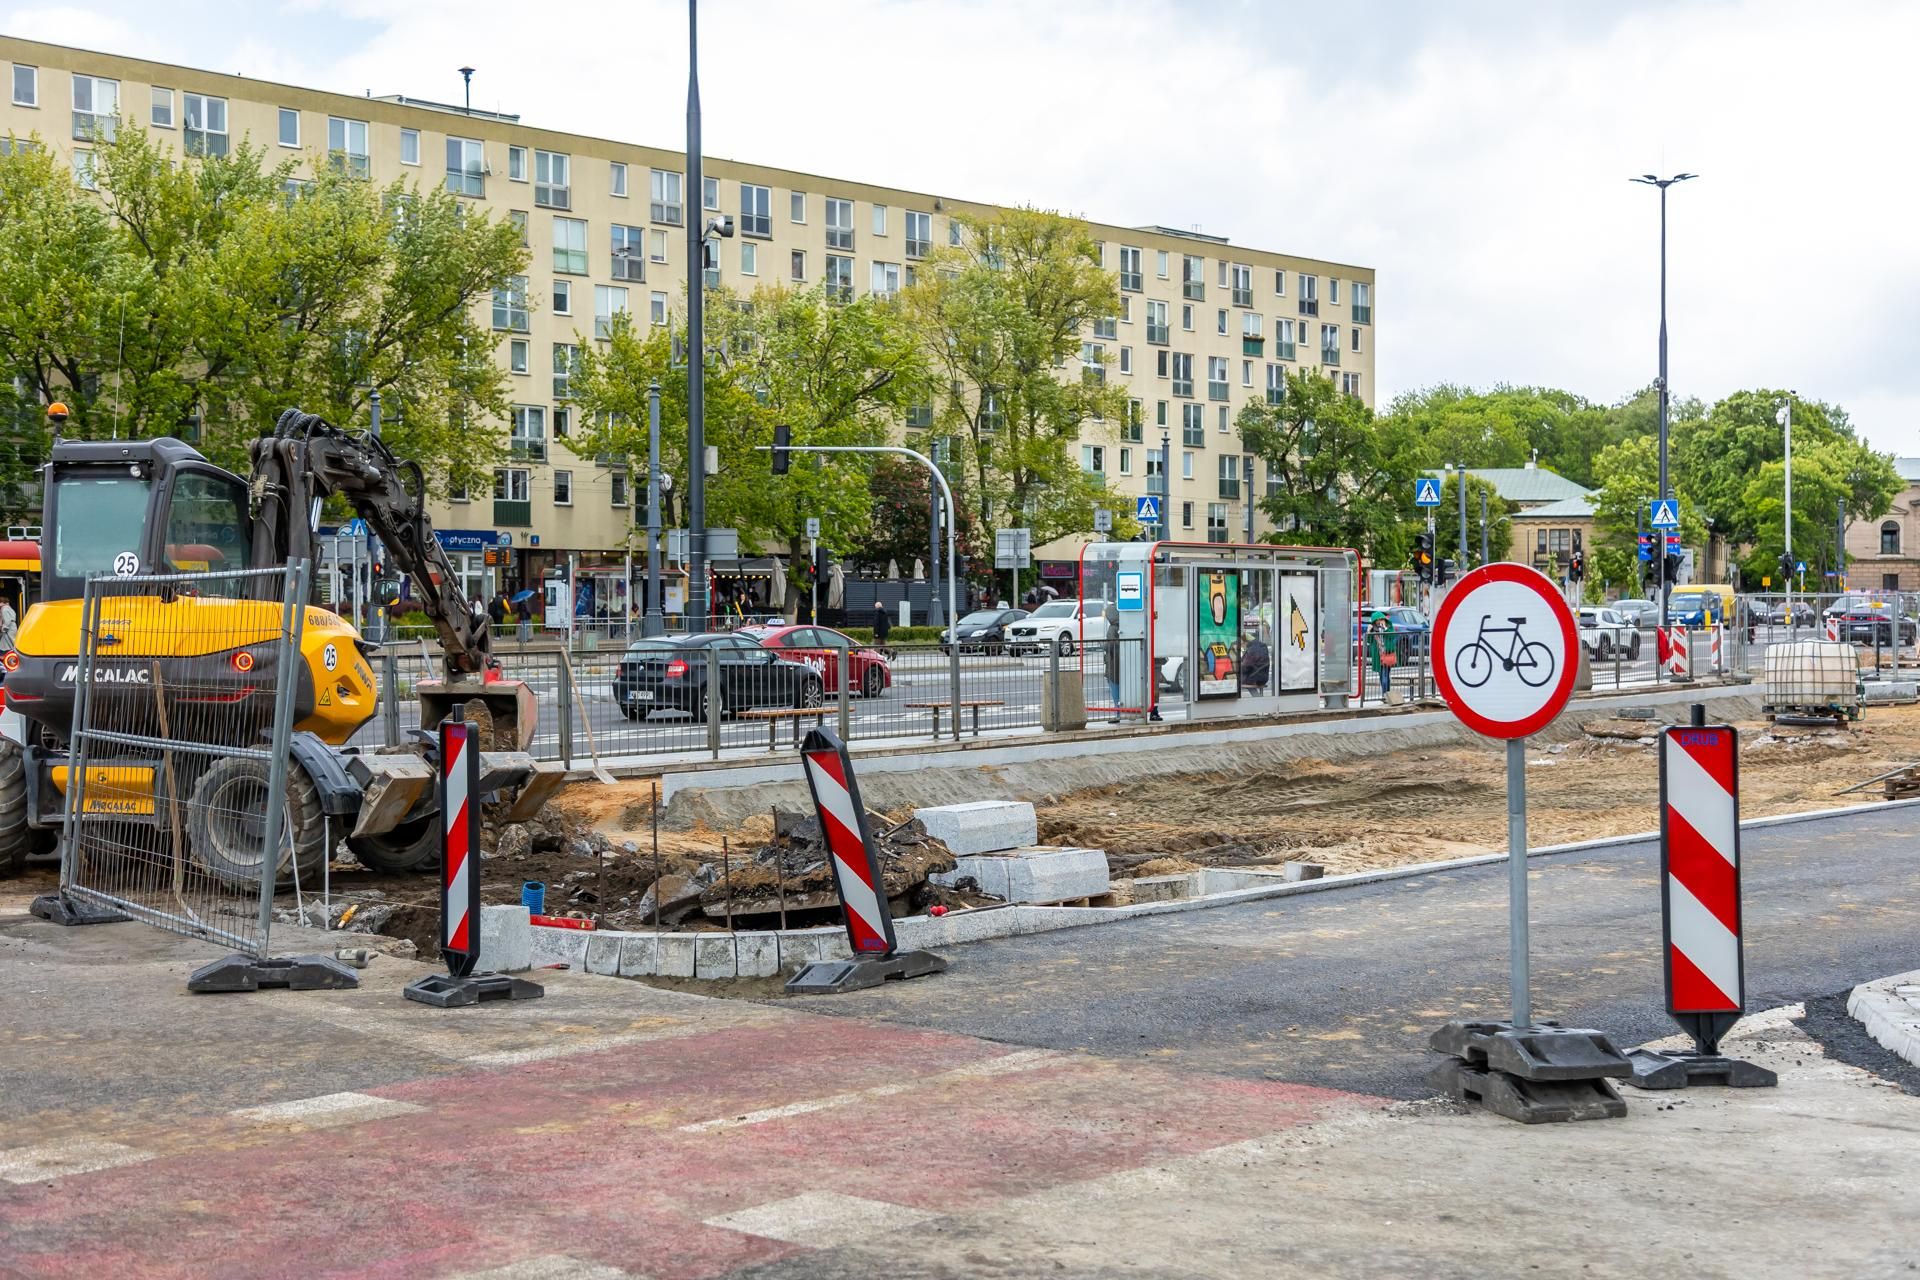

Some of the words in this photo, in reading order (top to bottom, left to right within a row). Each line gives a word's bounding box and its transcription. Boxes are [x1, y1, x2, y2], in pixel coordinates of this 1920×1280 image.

[117, 555, 135, 574] 25
[325, 648, 336, 667] 25
[1681, 733, 1719, 746] DRUB
